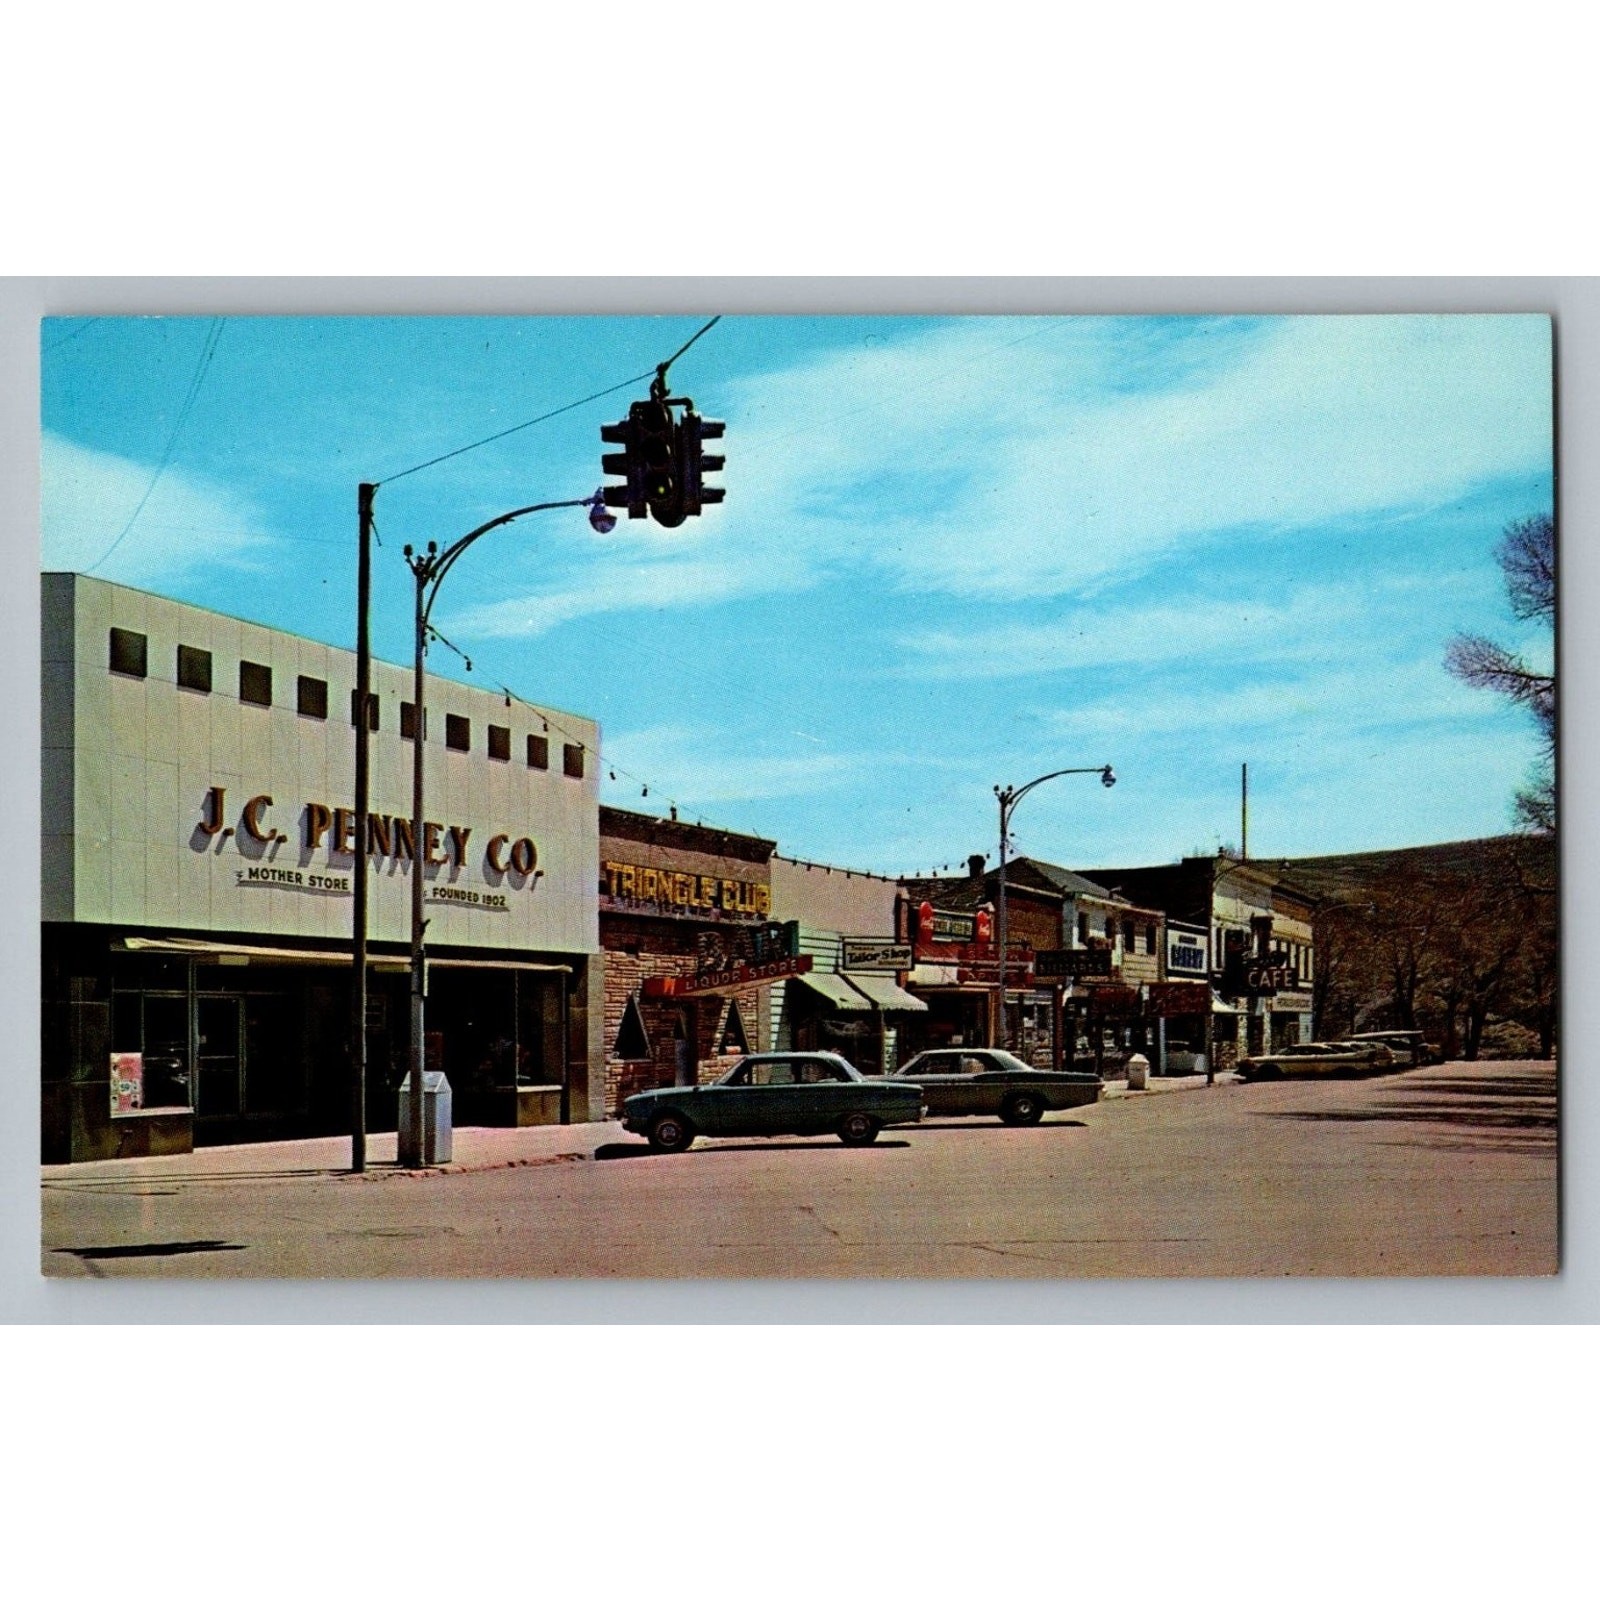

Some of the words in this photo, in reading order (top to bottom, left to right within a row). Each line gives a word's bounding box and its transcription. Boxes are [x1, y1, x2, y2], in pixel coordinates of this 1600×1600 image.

[306, 802, 472, 867] PENNEY
[486, 834, 544, 878] CO.
[248, 867, 303, 884] MOTHER
[308, 875, 349, 890] STORE
[606, 860, 715, 909] TRIANGLE
[722, 879, 771, 915] CLUB
[432, 887, 479, 903] FOUNDED
[482, 894, 506, 907] 1902
[881, 947, 911, 960] Shop
[685, 970, 741, 991] LIQUOR
[750, 960, 798, 978] STORE
[1247, 968, 1295, 989] CAFE
